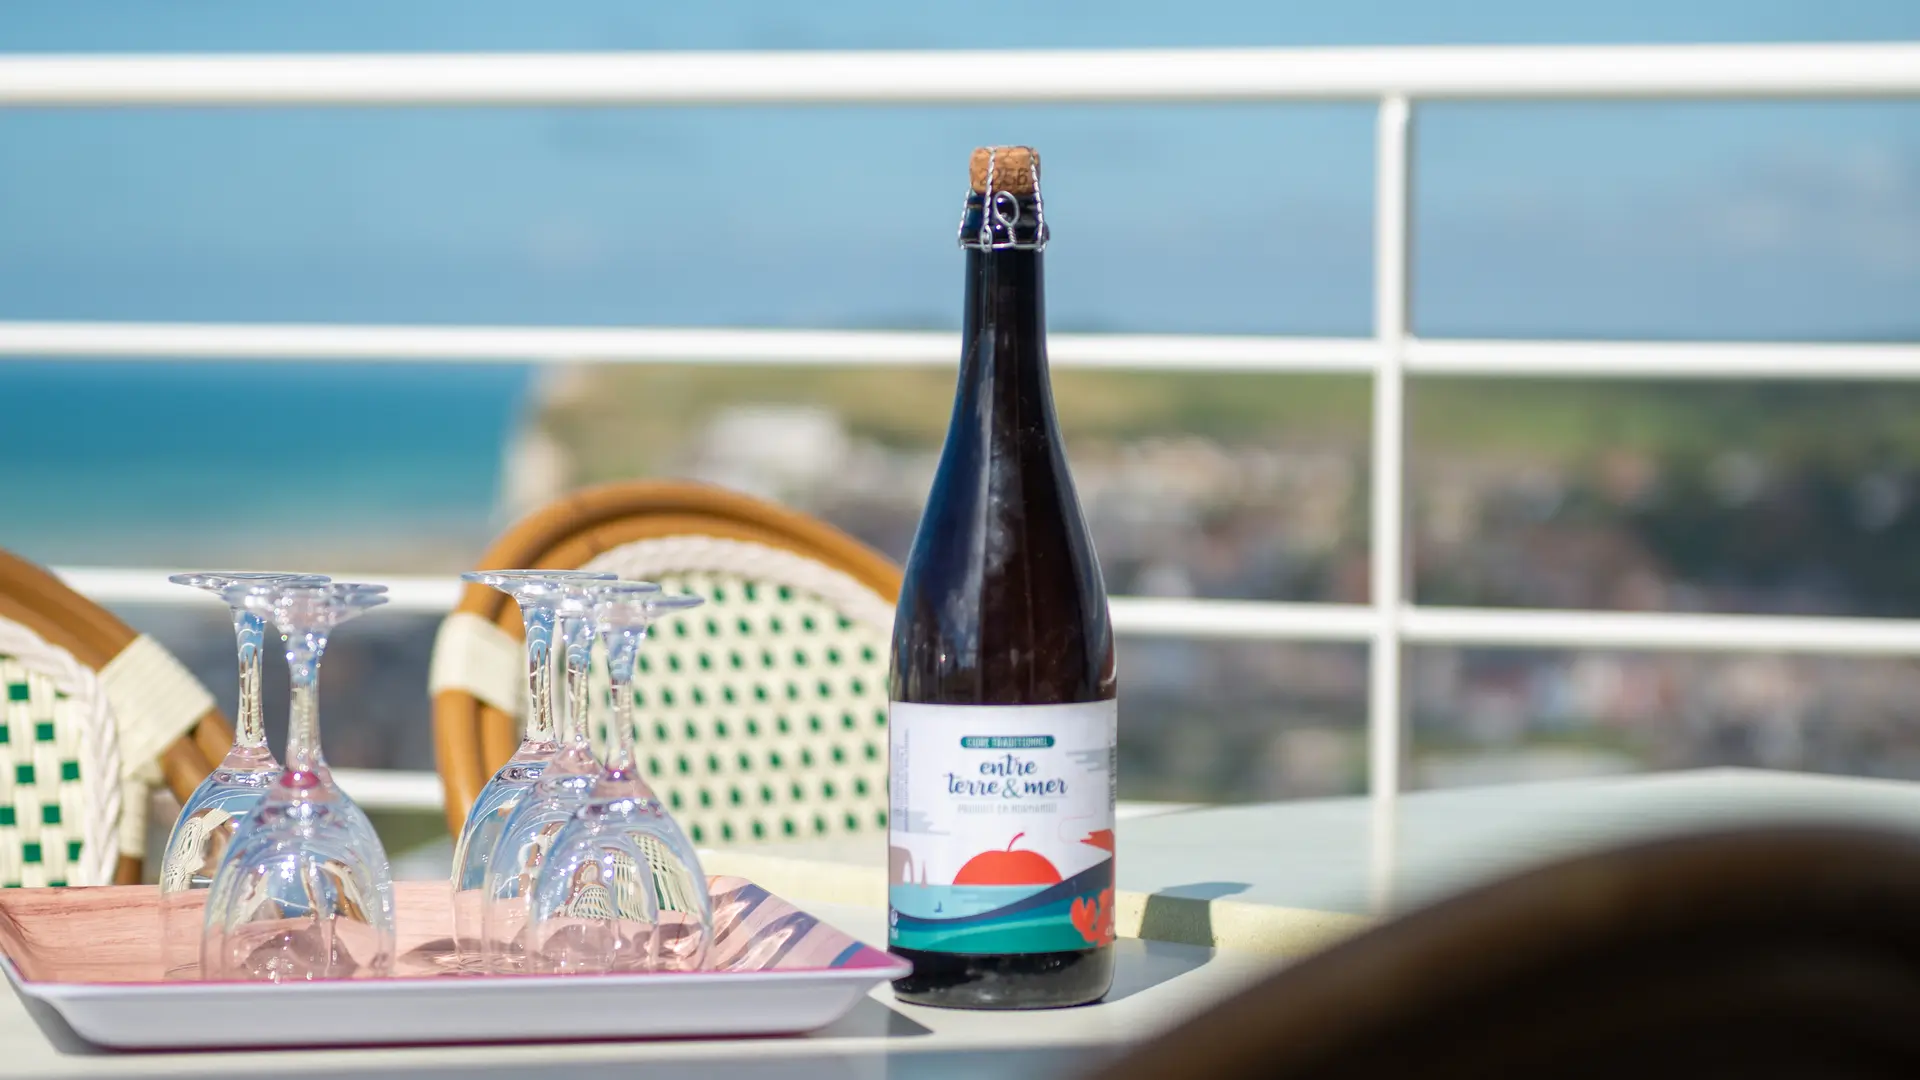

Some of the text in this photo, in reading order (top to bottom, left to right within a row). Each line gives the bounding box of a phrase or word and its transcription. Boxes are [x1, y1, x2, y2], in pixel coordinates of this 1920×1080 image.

[980, 753, 1037, 776] entre
[945, 772, 1068, 798] terre & mer
